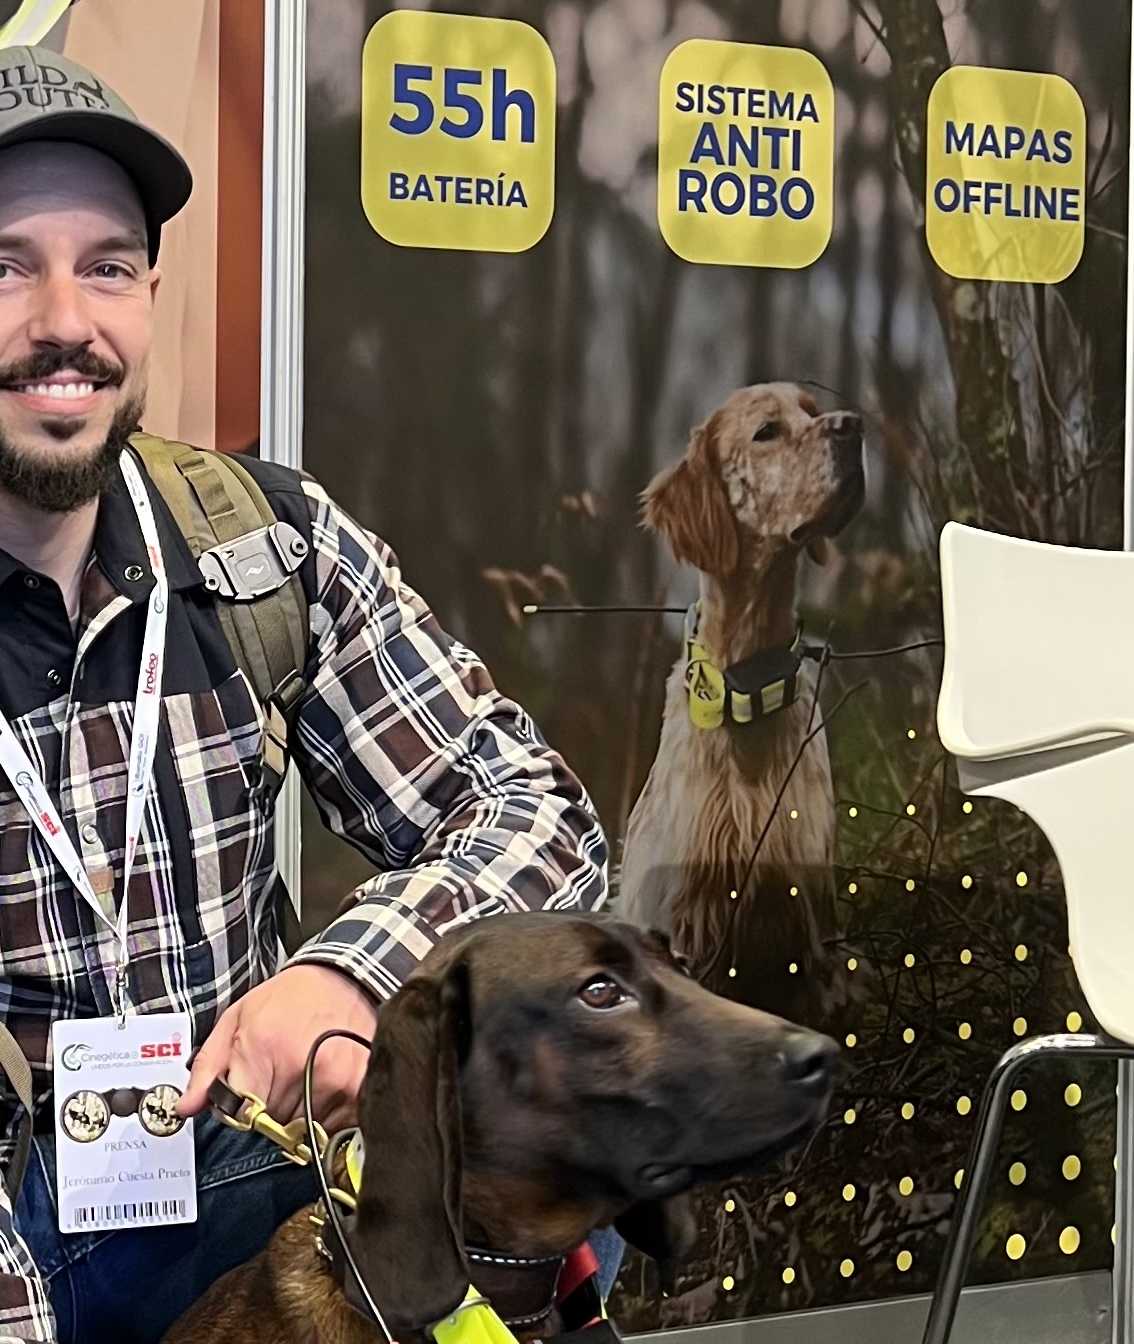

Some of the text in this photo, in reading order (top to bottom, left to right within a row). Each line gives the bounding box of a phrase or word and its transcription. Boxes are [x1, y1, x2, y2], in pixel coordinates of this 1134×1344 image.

[389, 64, 536, 143] 55h
[676, 83, 819, 124] SISTEMA
[690, 122, 802, 171] ANTI
[945, 121, 1073, 164] MAPAS
[389, 172, 528, 208] BATERÍA
[678, 170, 814, 220] ROBO
[934, 179, 1079, 222] OFFLINE
[143, 653, 157, 695] trofeo
[104, 1140, 147, 1152] PRENSA
[118, 1171, 155, 1182] Cuesta
